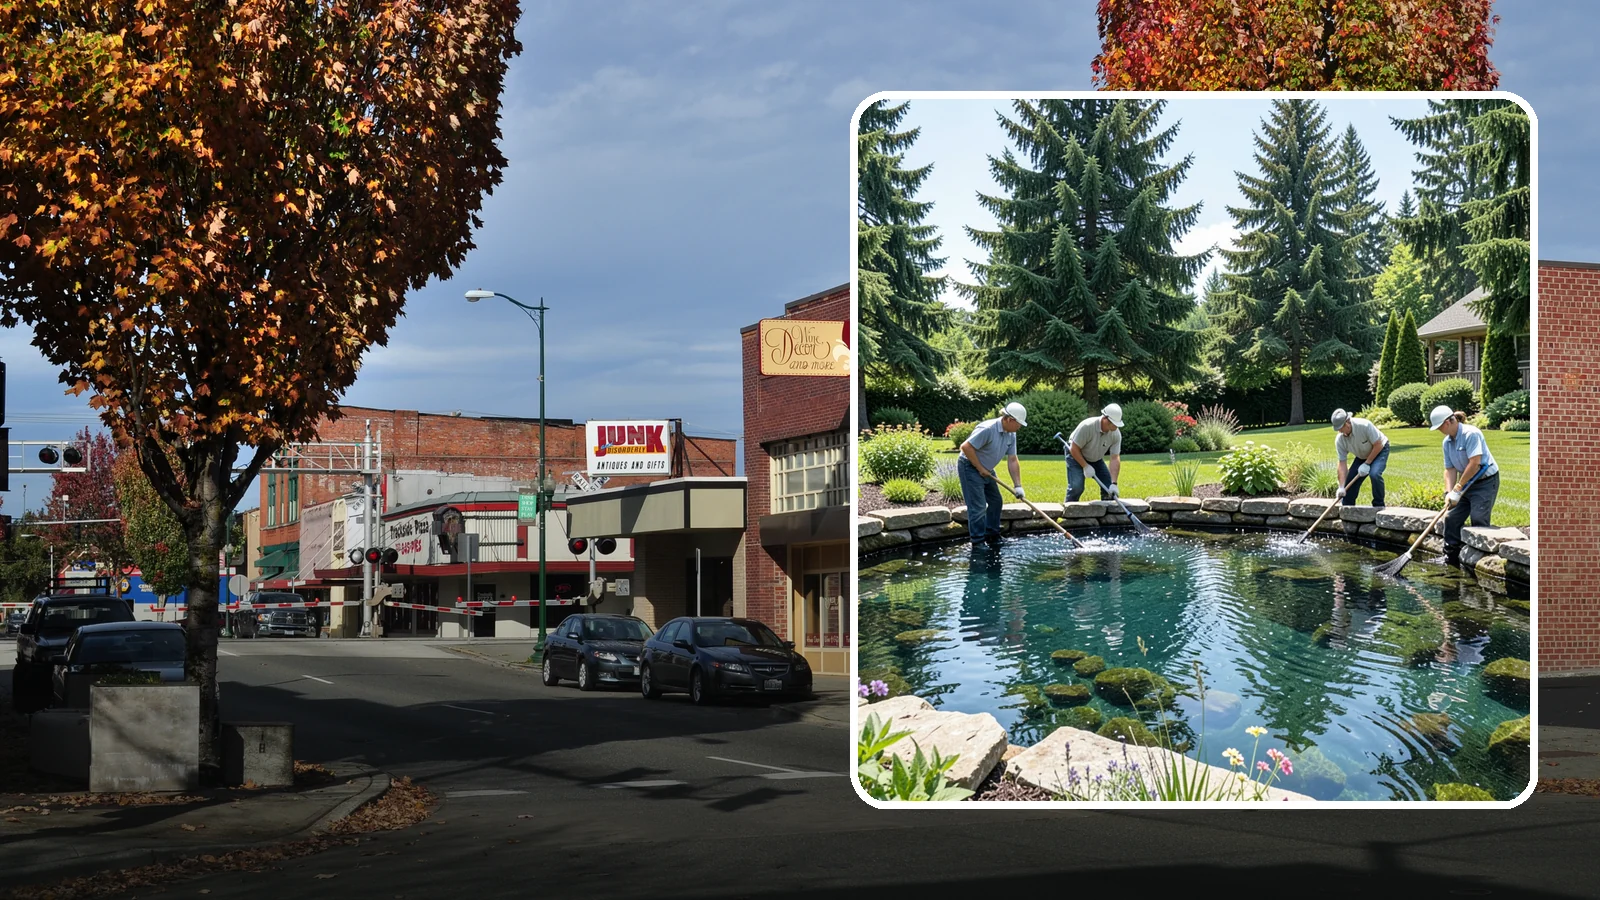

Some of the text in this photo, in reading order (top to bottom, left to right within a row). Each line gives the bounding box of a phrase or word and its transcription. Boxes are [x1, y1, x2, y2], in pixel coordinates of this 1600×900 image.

[765, 328, 831, 365] Decor
[596, 425, 664, 457] JUNK
[607, 446, 646, 454] DISORDERLY
[597, 460, 665, 470] ANTIQUES AND GIFTS
[573, 473, 588, 491] RAIL
[590, 476, 608, 491] SING
[390, 520, 429, 540] Trackside Pizza
